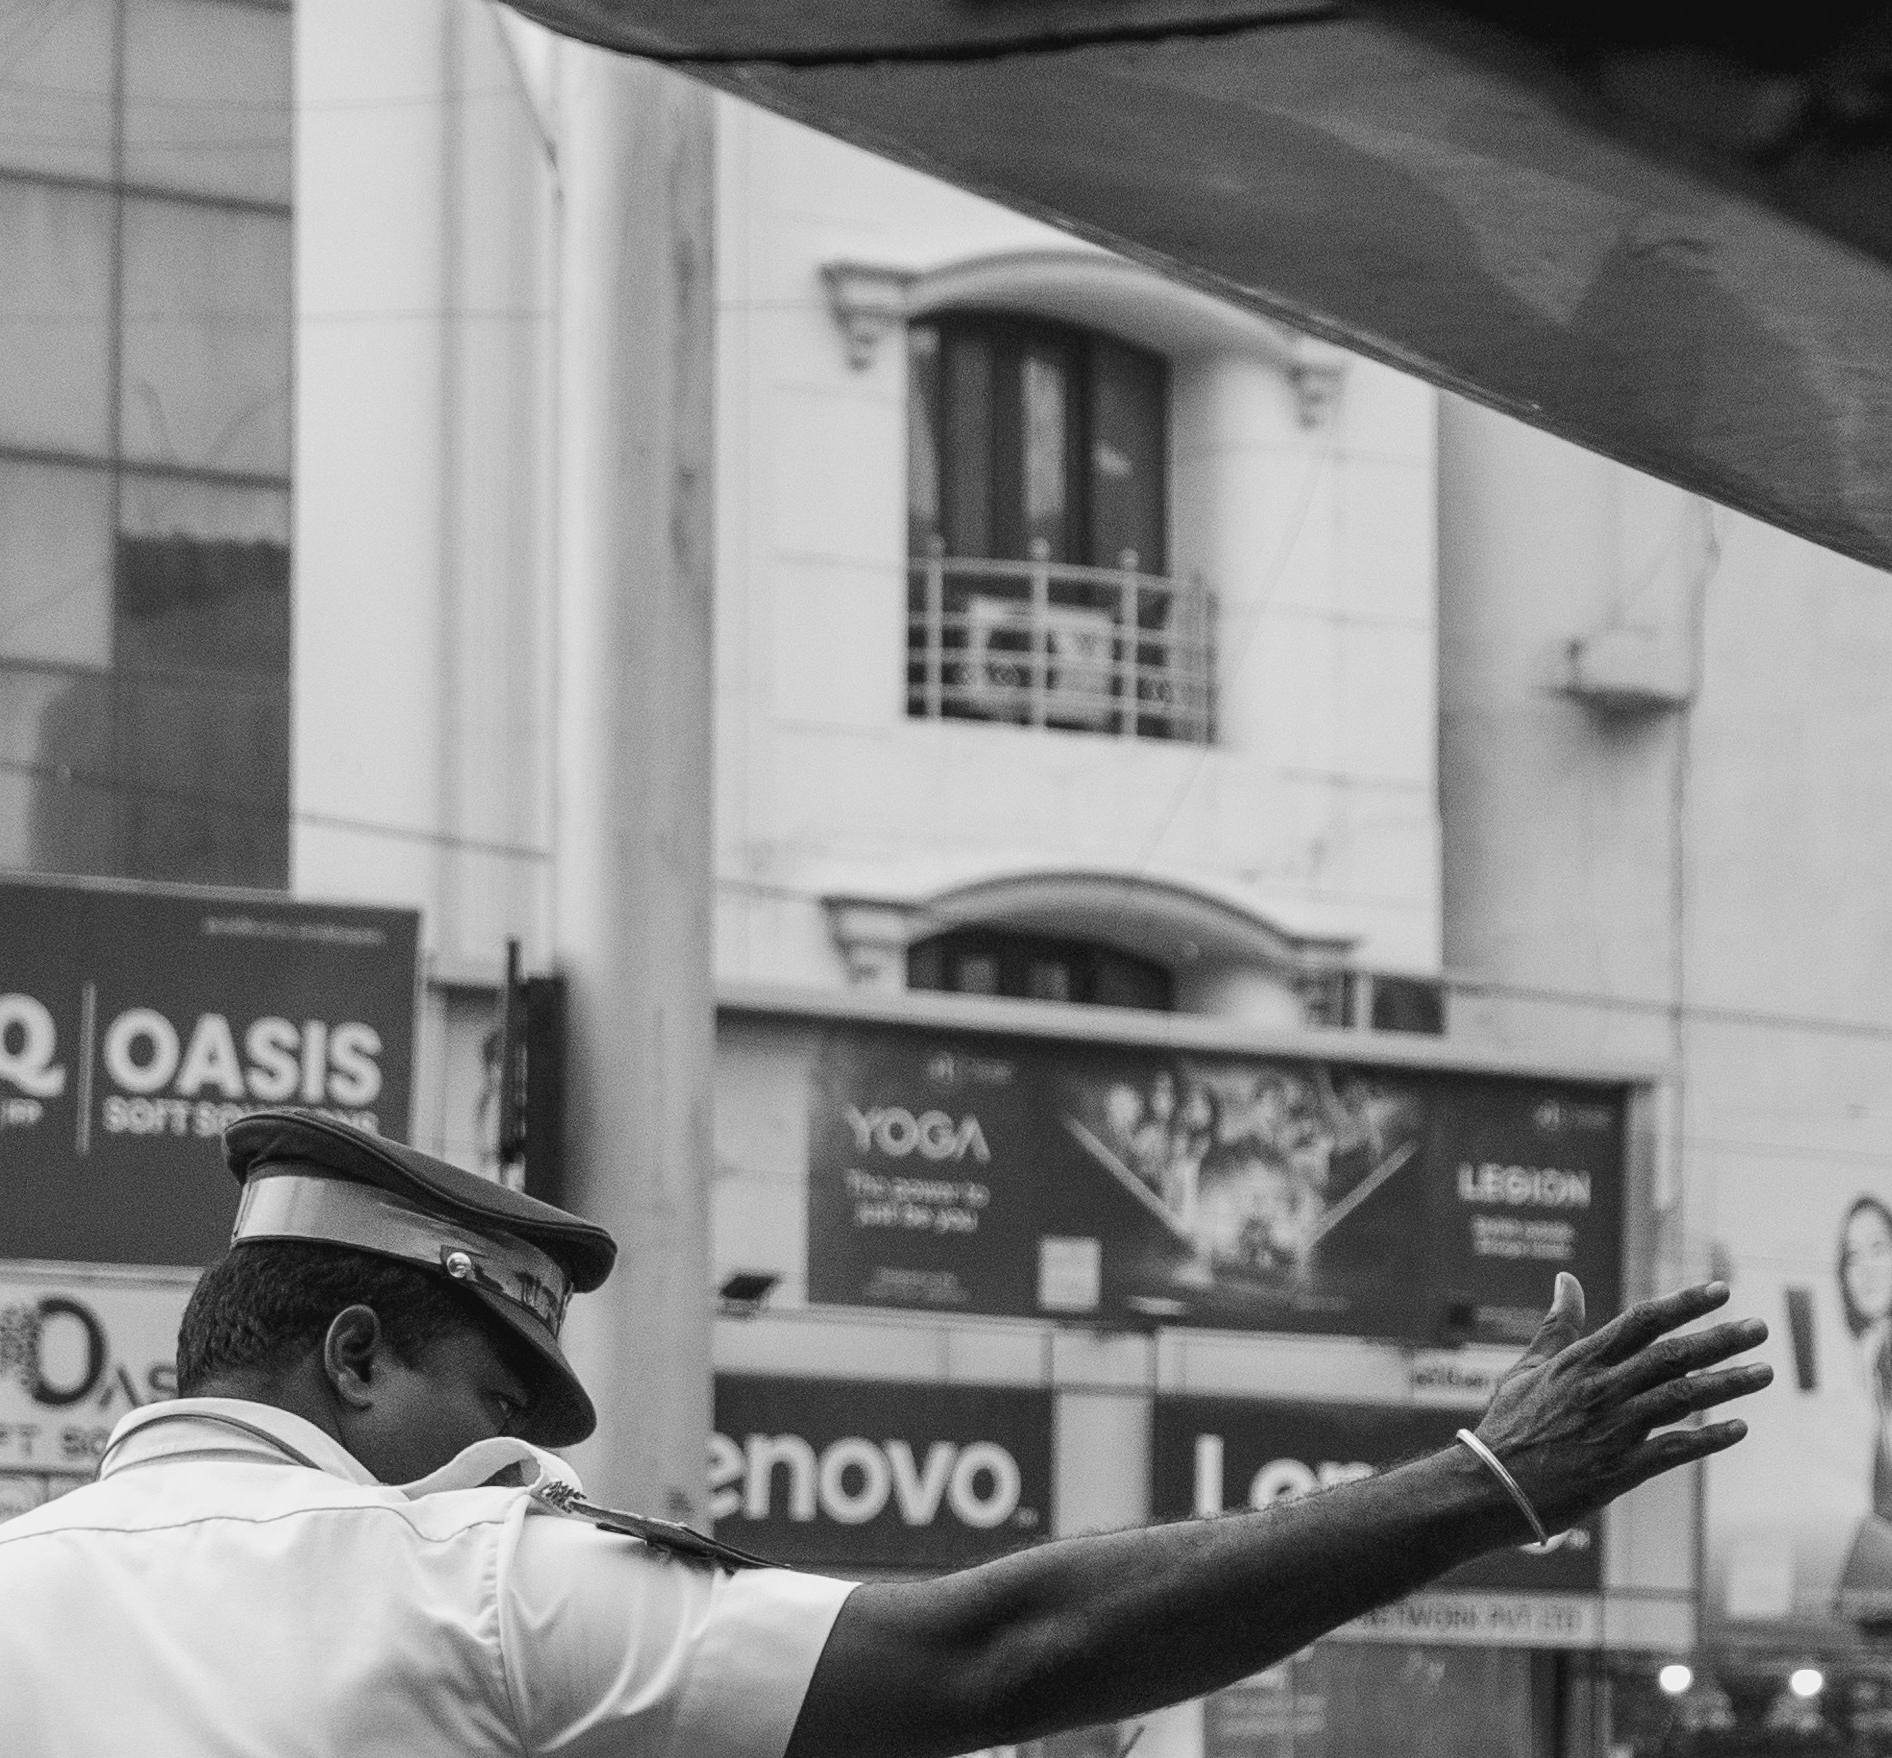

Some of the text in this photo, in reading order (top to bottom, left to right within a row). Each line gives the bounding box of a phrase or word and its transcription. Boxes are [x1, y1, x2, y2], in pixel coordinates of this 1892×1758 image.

[104, 1007, 383, 1107] OASIS
[843, 1102, 991, 1163] YOGA
[1457, 1161, 1591, 1207] LEGION
[708, 1432, 1021, 1529] enovo
